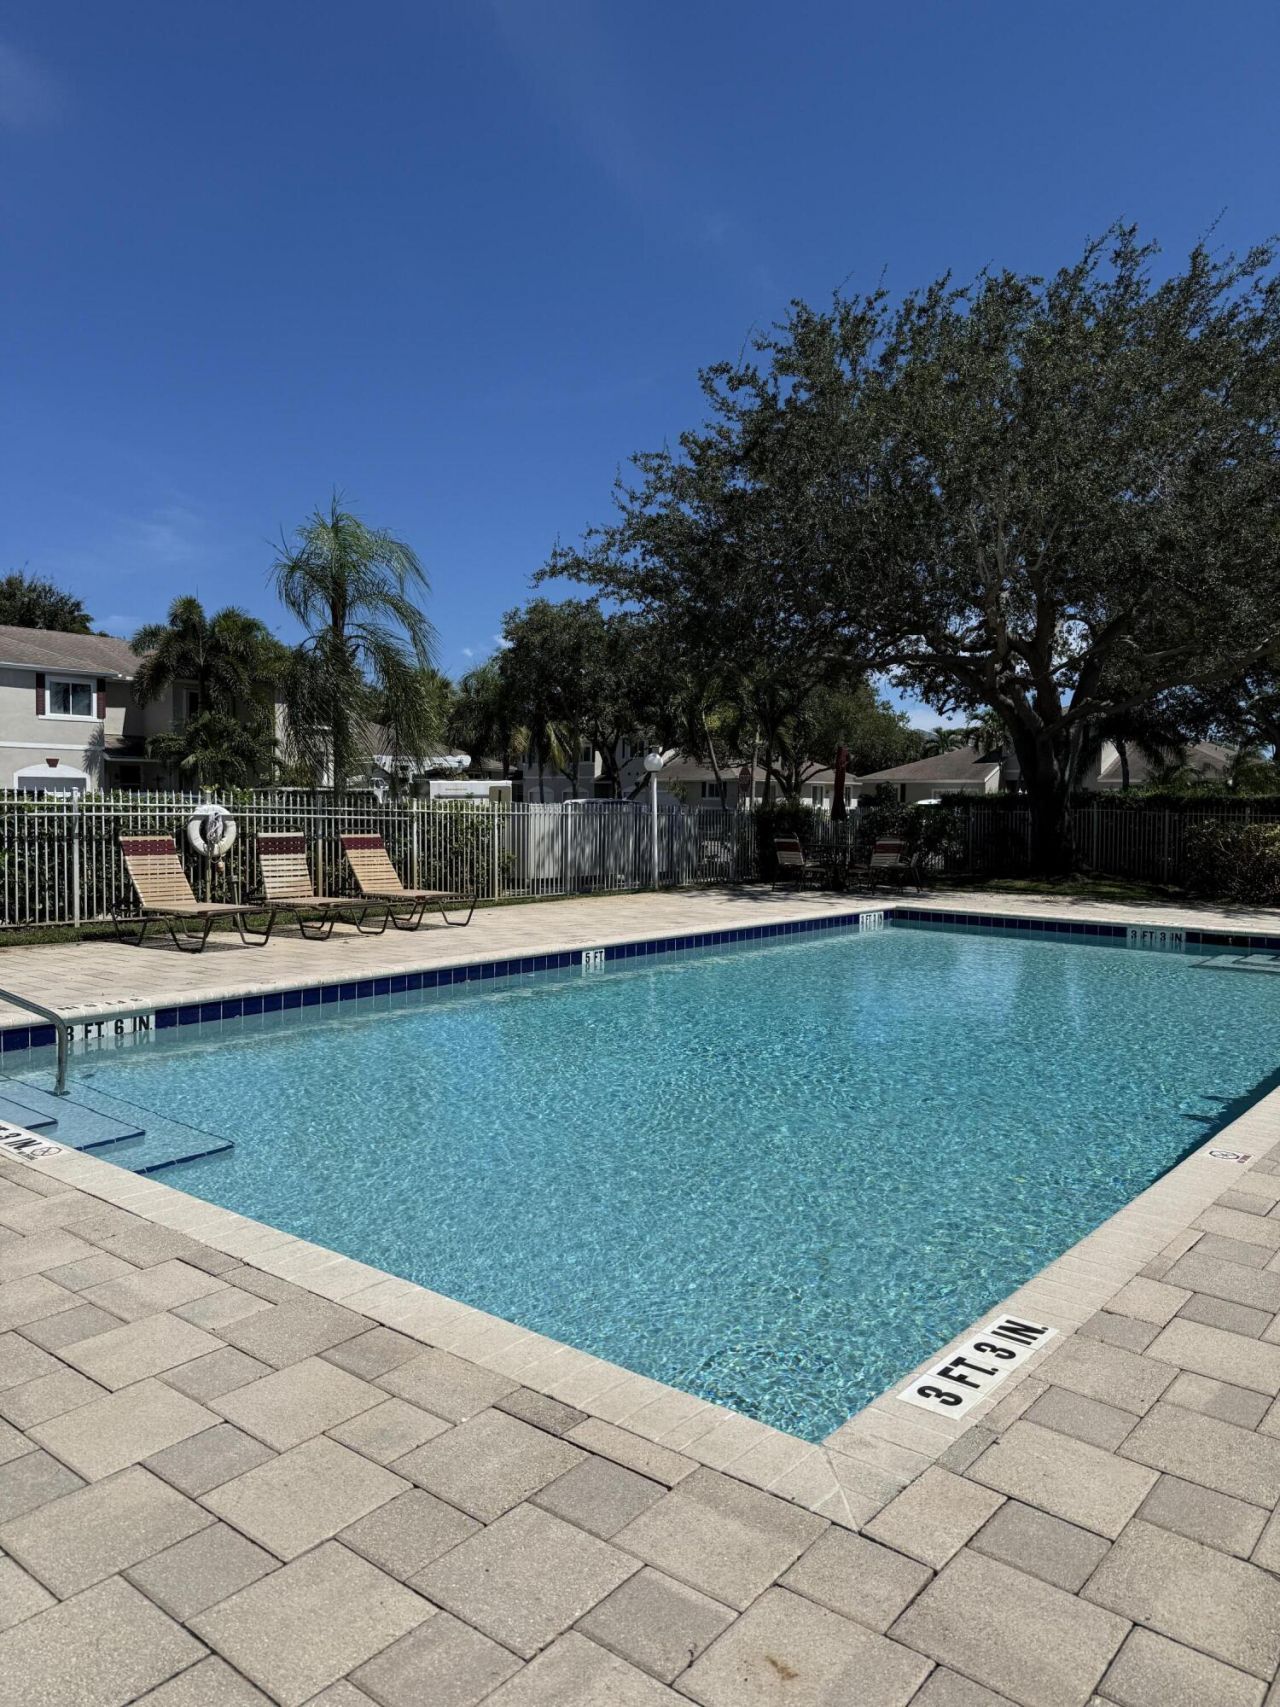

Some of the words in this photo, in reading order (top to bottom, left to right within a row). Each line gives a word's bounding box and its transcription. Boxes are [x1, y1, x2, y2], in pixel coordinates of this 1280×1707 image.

[85, 1021, 105, 1039] FT.
[114, 1018, 124, 1035] 6
[990, 1319, 1049, 1346] IN.
[973, 1342, 1017, 1360] 3
[936, 1356, 999, 1389] FT.
[917, 1385, 963, 1407] 3
